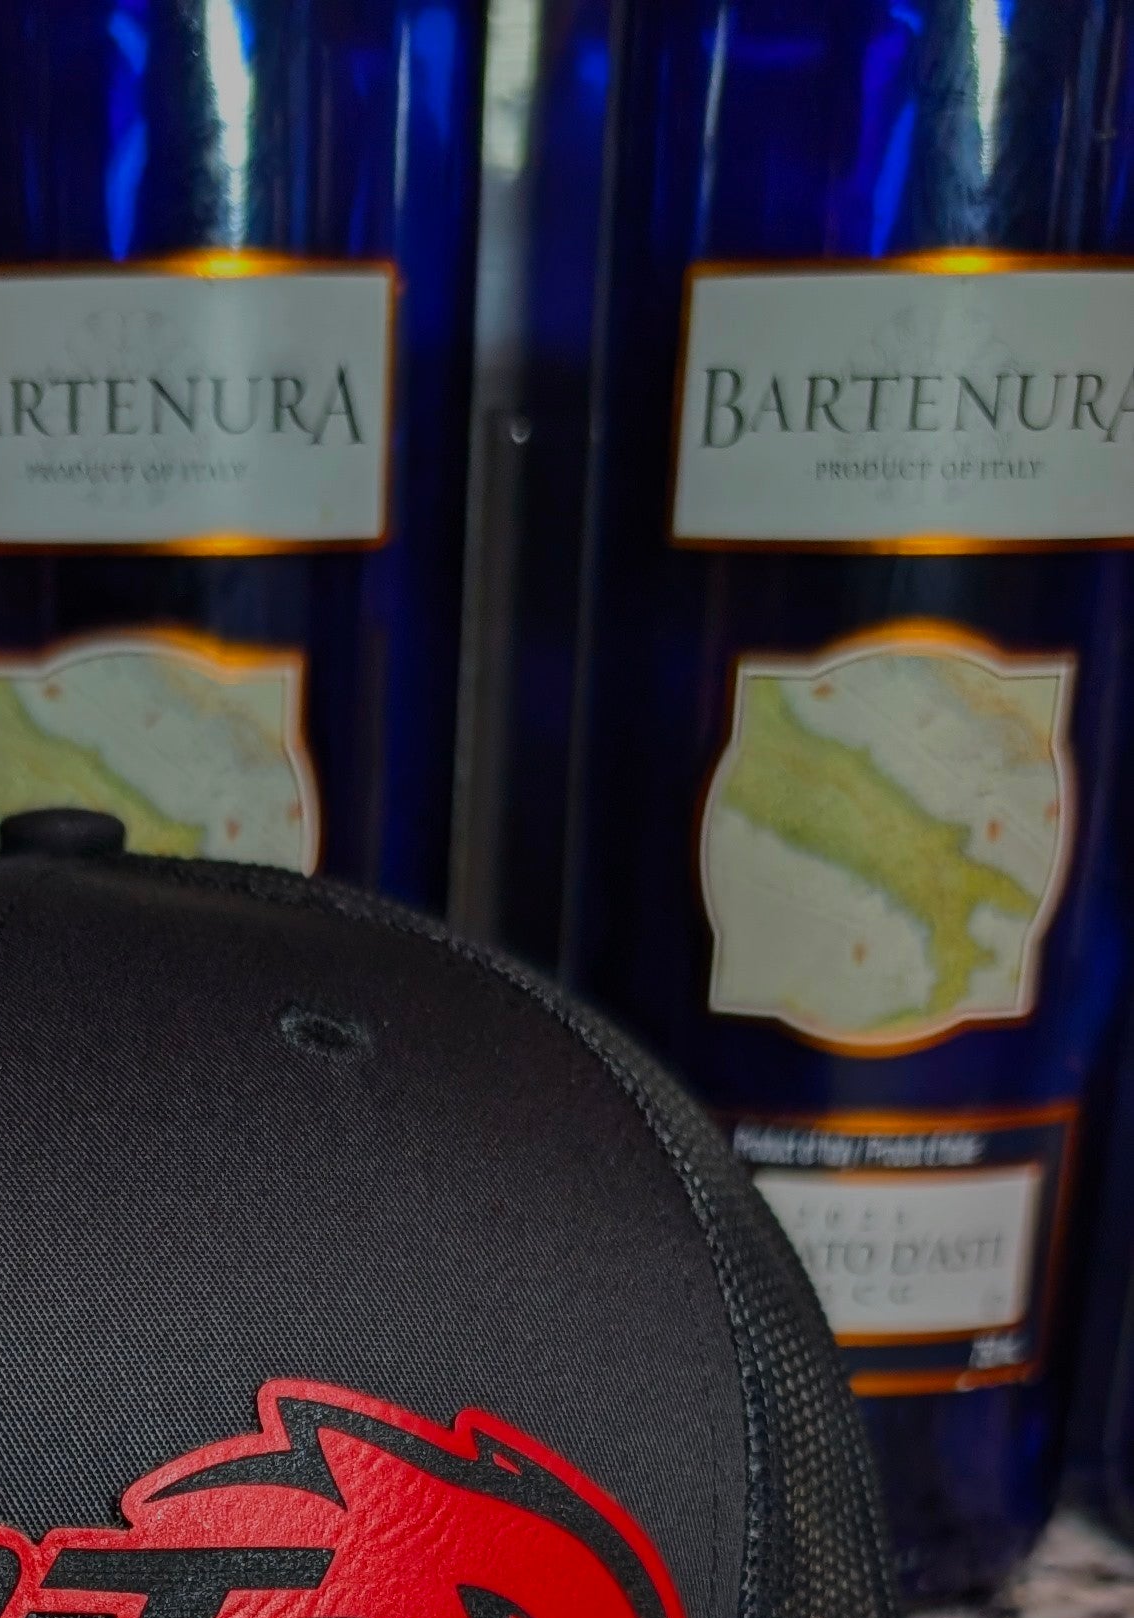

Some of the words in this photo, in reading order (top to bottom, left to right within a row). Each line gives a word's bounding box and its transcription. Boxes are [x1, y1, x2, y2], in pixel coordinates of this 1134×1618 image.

[815, 457, 932, 482] PRODUCT
[941, 459, 973, 482] OF
[979, 459, 1044, 481] ITALY
